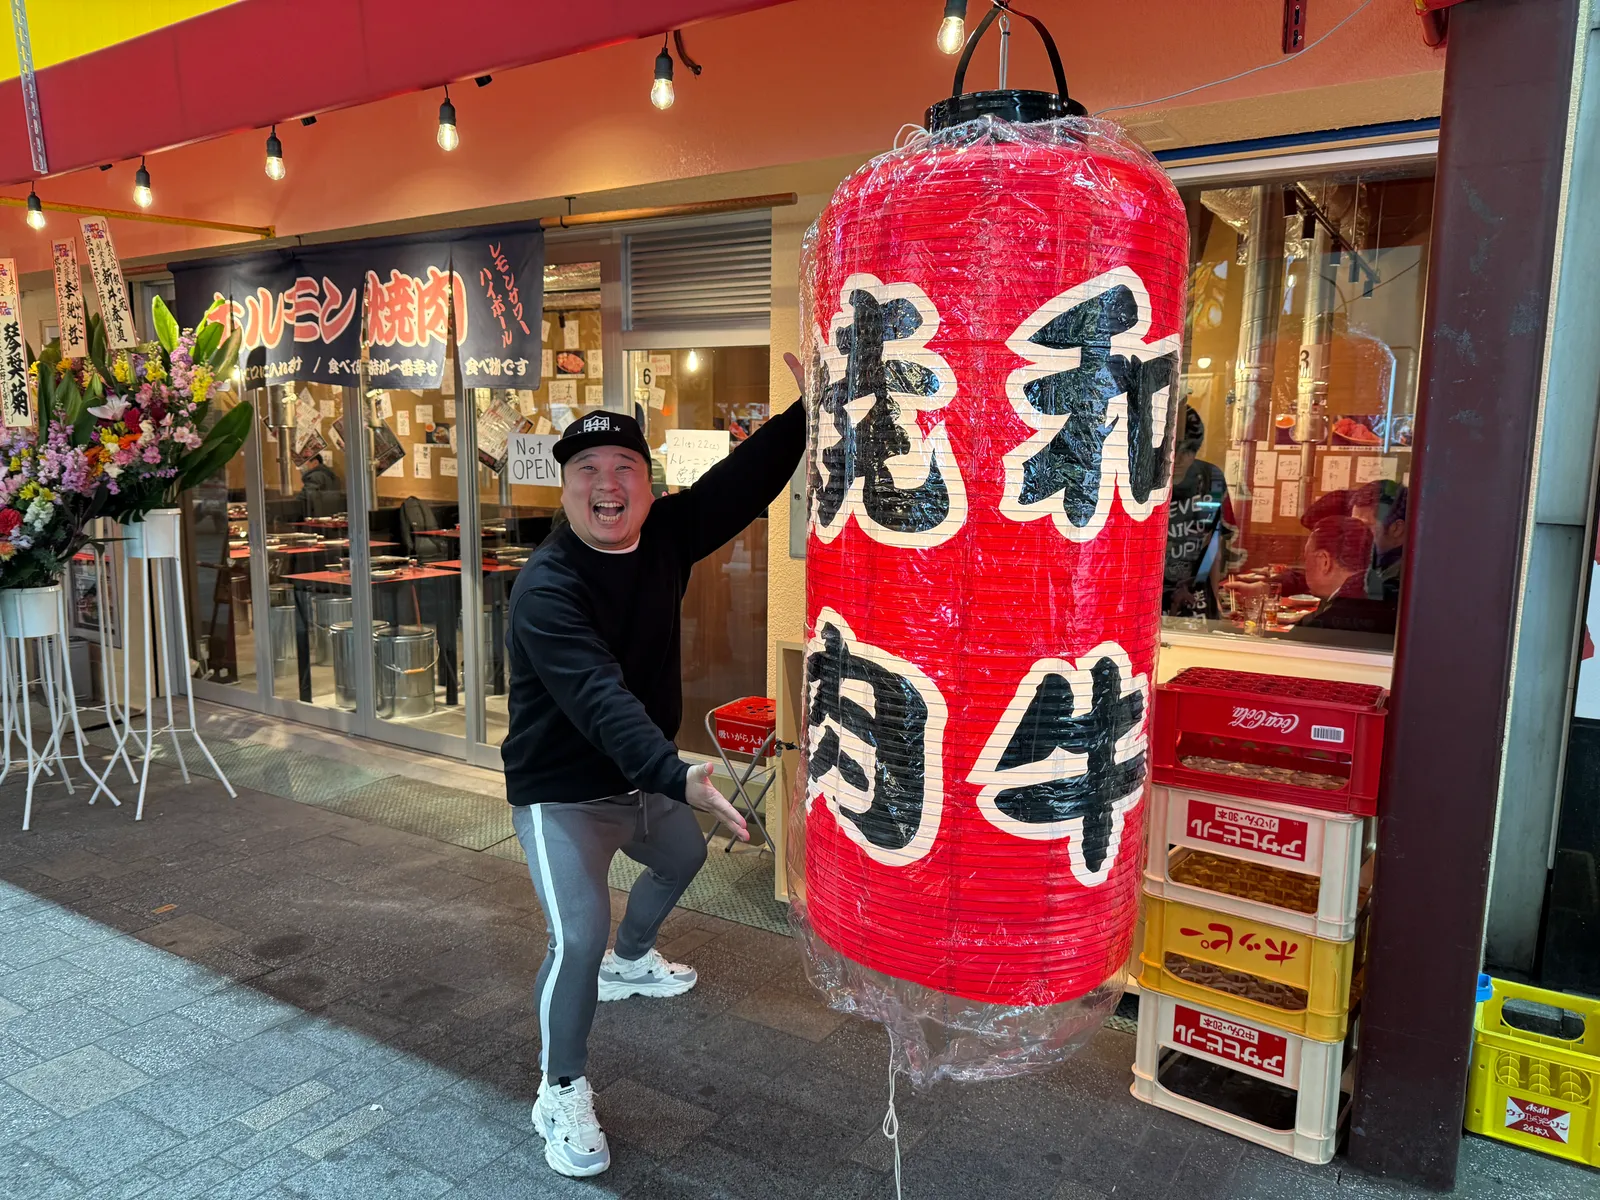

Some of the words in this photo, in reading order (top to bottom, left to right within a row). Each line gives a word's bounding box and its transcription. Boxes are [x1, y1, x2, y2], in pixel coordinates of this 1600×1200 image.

[489, 241, 530, 335] レモンサワー
[480, 267, 513, 348] ハイボール
[3, 321, 29, 417] 琴奨菊
[1300, 350, 1310, 371] 3
[643, 368, 652, 385] 6
[516, 438, 543, 455] Not
[513, 459, 556, 480] OPEN
[1168, 495, 1213, 518] EVER
[805, 272, 967, 866] 焼肉
[966, 265, 1181, 887] 和牛
[718, 729, 764, 745] 吸いがら入れ
[1218, 809, 1277, 831] 小びん・30本
[1191, 819, 1302, 857] アサヒビール
[1180, 923, 1299, 967] ホッピー
[1203, 1018, 1256, 1042] 中びん・20本
[1176, 1024, 1283, 1074] アサヒビール
[1506, 1109, 1568, 1131] ウィルキンソン
[1525, 1103, 1550, 1116] Asahi
[1523, 1123, 1550, 1138] 24本入
